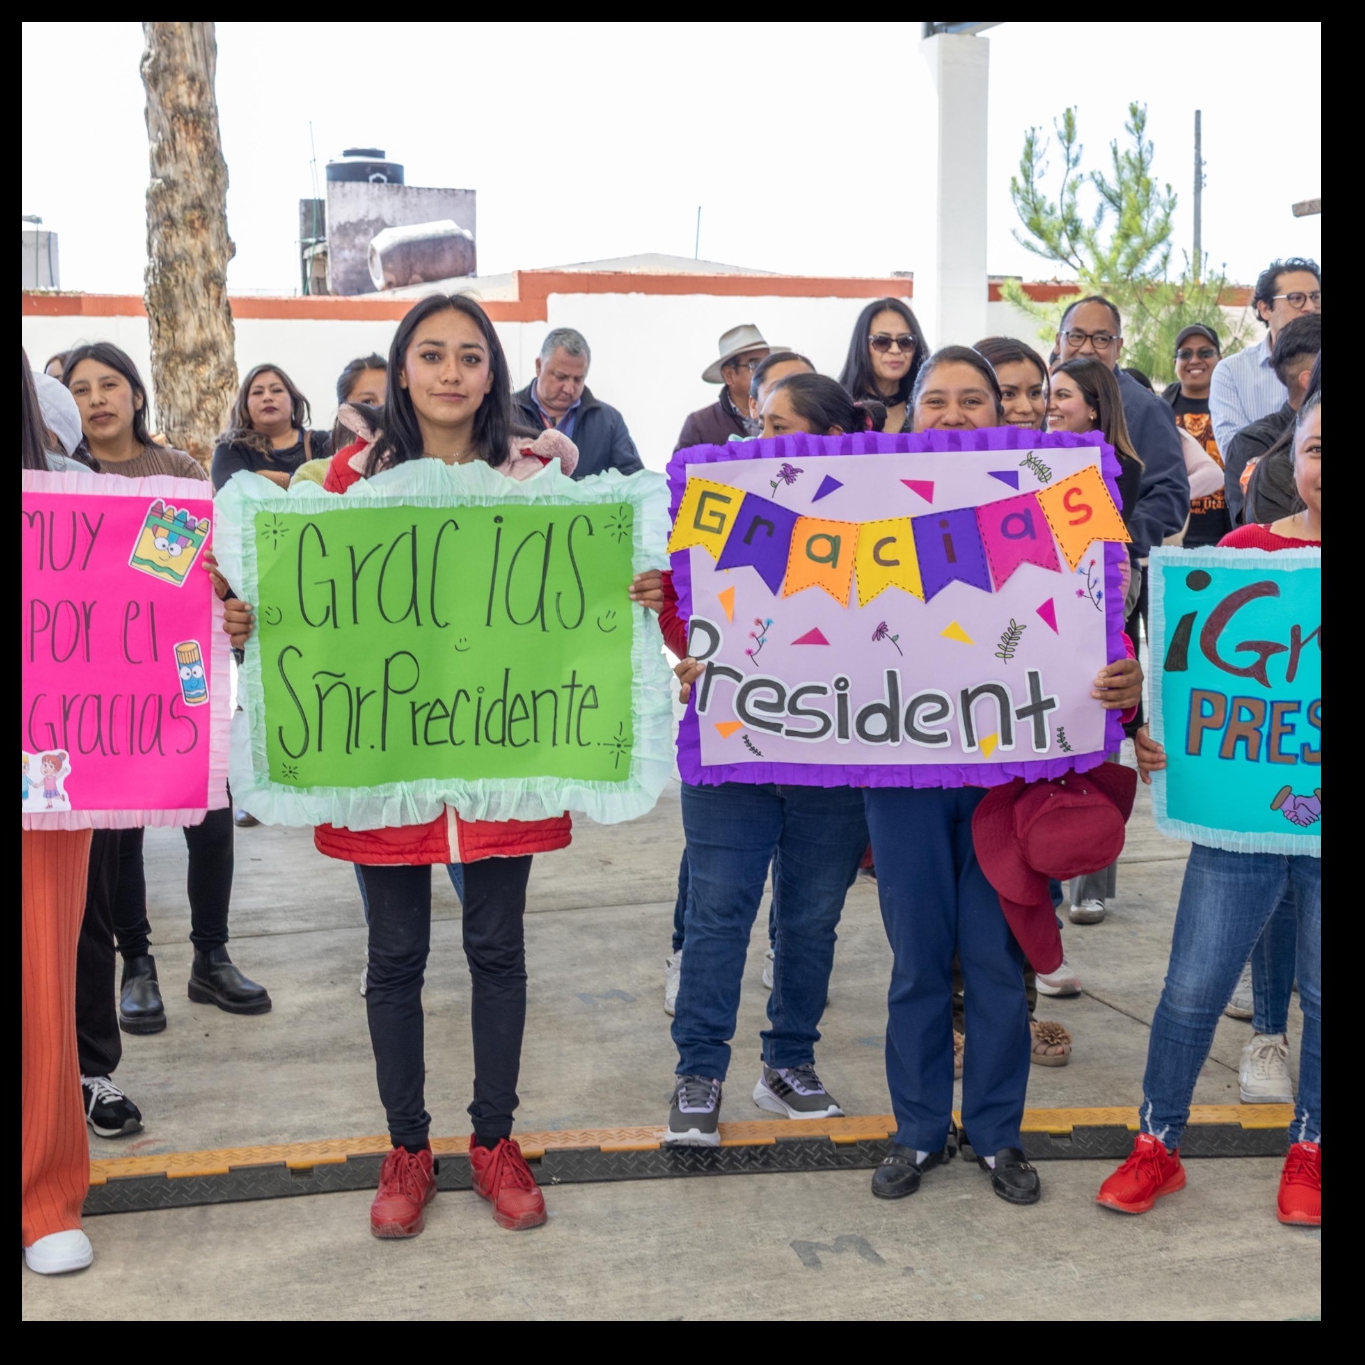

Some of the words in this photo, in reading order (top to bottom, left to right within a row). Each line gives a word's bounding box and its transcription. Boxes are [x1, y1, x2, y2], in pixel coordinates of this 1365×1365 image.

[297, 514, 595, 633] Gracias
[692, 486, 1094, 569] Gracias
[1164, 569, 1321, 693] ¡Gr
[27, 693, 199, 757] Gracias
